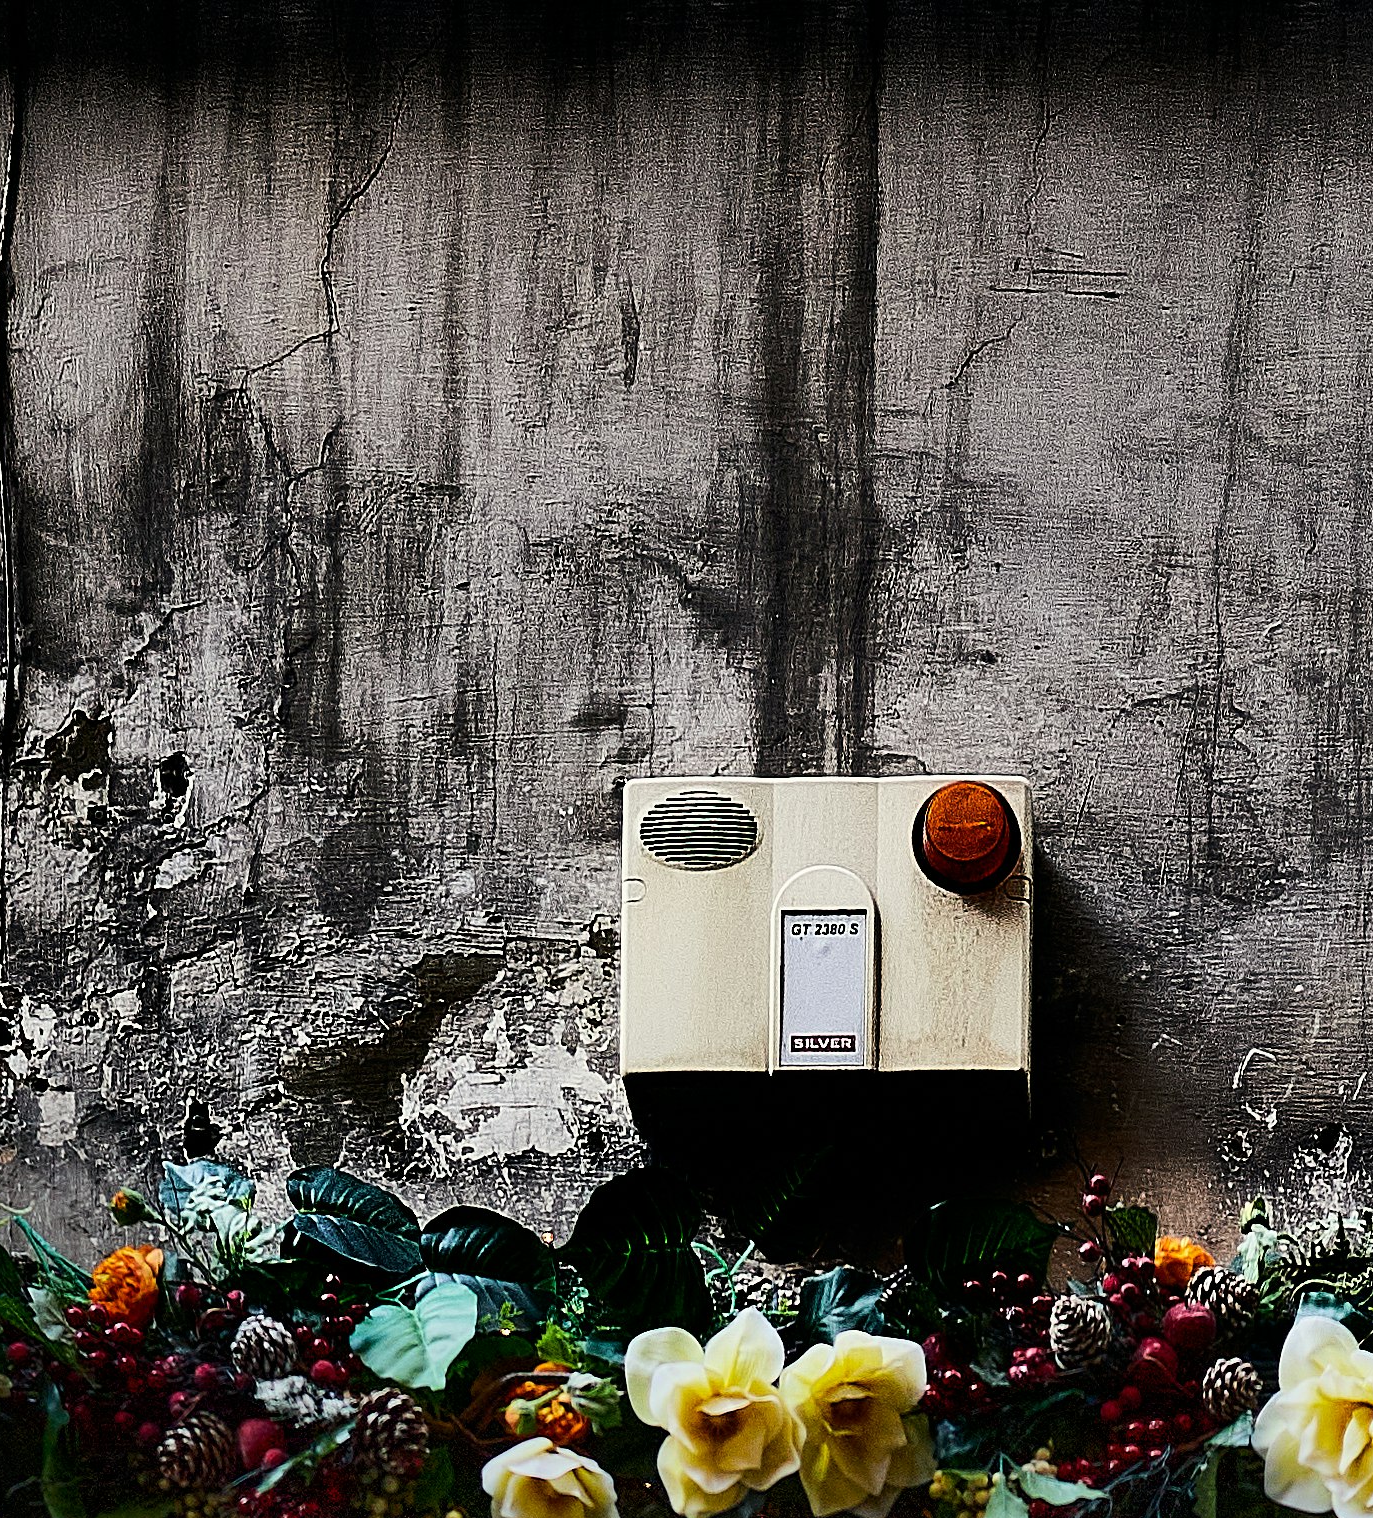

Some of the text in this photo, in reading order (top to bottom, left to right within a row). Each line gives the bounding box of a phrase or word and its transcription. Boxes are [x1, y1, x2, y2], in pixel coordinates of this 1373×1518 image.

[791, 923, 810, 935] GT
[849, 922, 859, 935] S
[793, 1037, 853, 1049] SILVER
